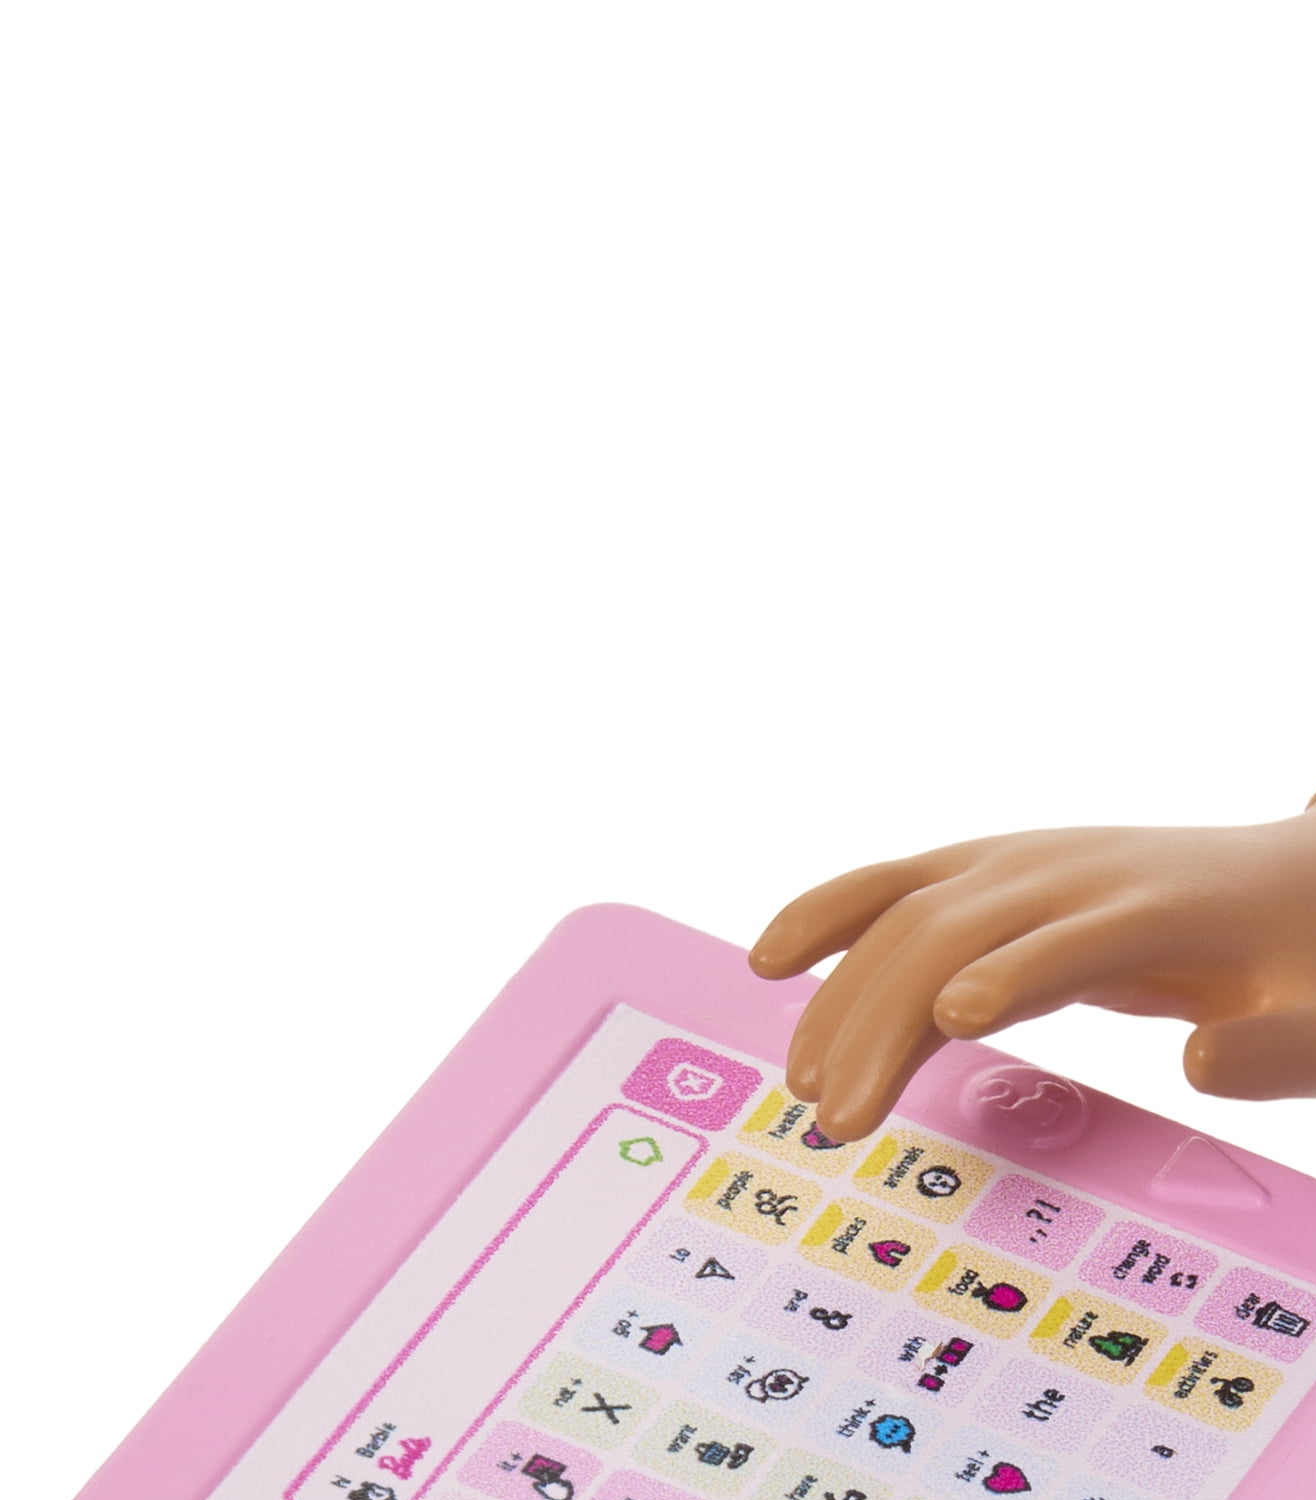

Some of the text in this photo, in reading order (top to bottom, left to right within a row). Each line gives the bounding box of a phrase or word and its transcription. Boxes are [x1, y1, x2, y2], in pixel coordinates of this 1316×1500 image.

[768, 1103, 807, 1139] health
[883, 1146, 925, 1189] animals
[716, 1171, 754, 1211] people
[831, 1217, 867, 1255] places
[669, 1248, 691, 1262] to
[1111, 1239, 1152, 1280] change
[1141, 1253, 1171, 1284] word
[947, 1267, 979, 1296] food
[783, 1289, 809, 1312] and
[1233, 1292, 1261, 1321] clear
[612, 1319, 632, 1338] go
[1062, 1311, 1099, 1349] nature
[898, 1336, 927, 1362] with
[727, 1364, 752, 1385] say
[1173, 1350, 1219, 1399] activities
[553, 1387, 577, 1407] not
[1021, 1388, 1066, 1422] the
[836, 1406, 871, 1438] think
[355, 1423, 396, 1459] Barbie
[667, 1424, 698, 1453] want
[1150, 1444, 1175, 1459] a
[955, 1457, 984, 1483] feel
